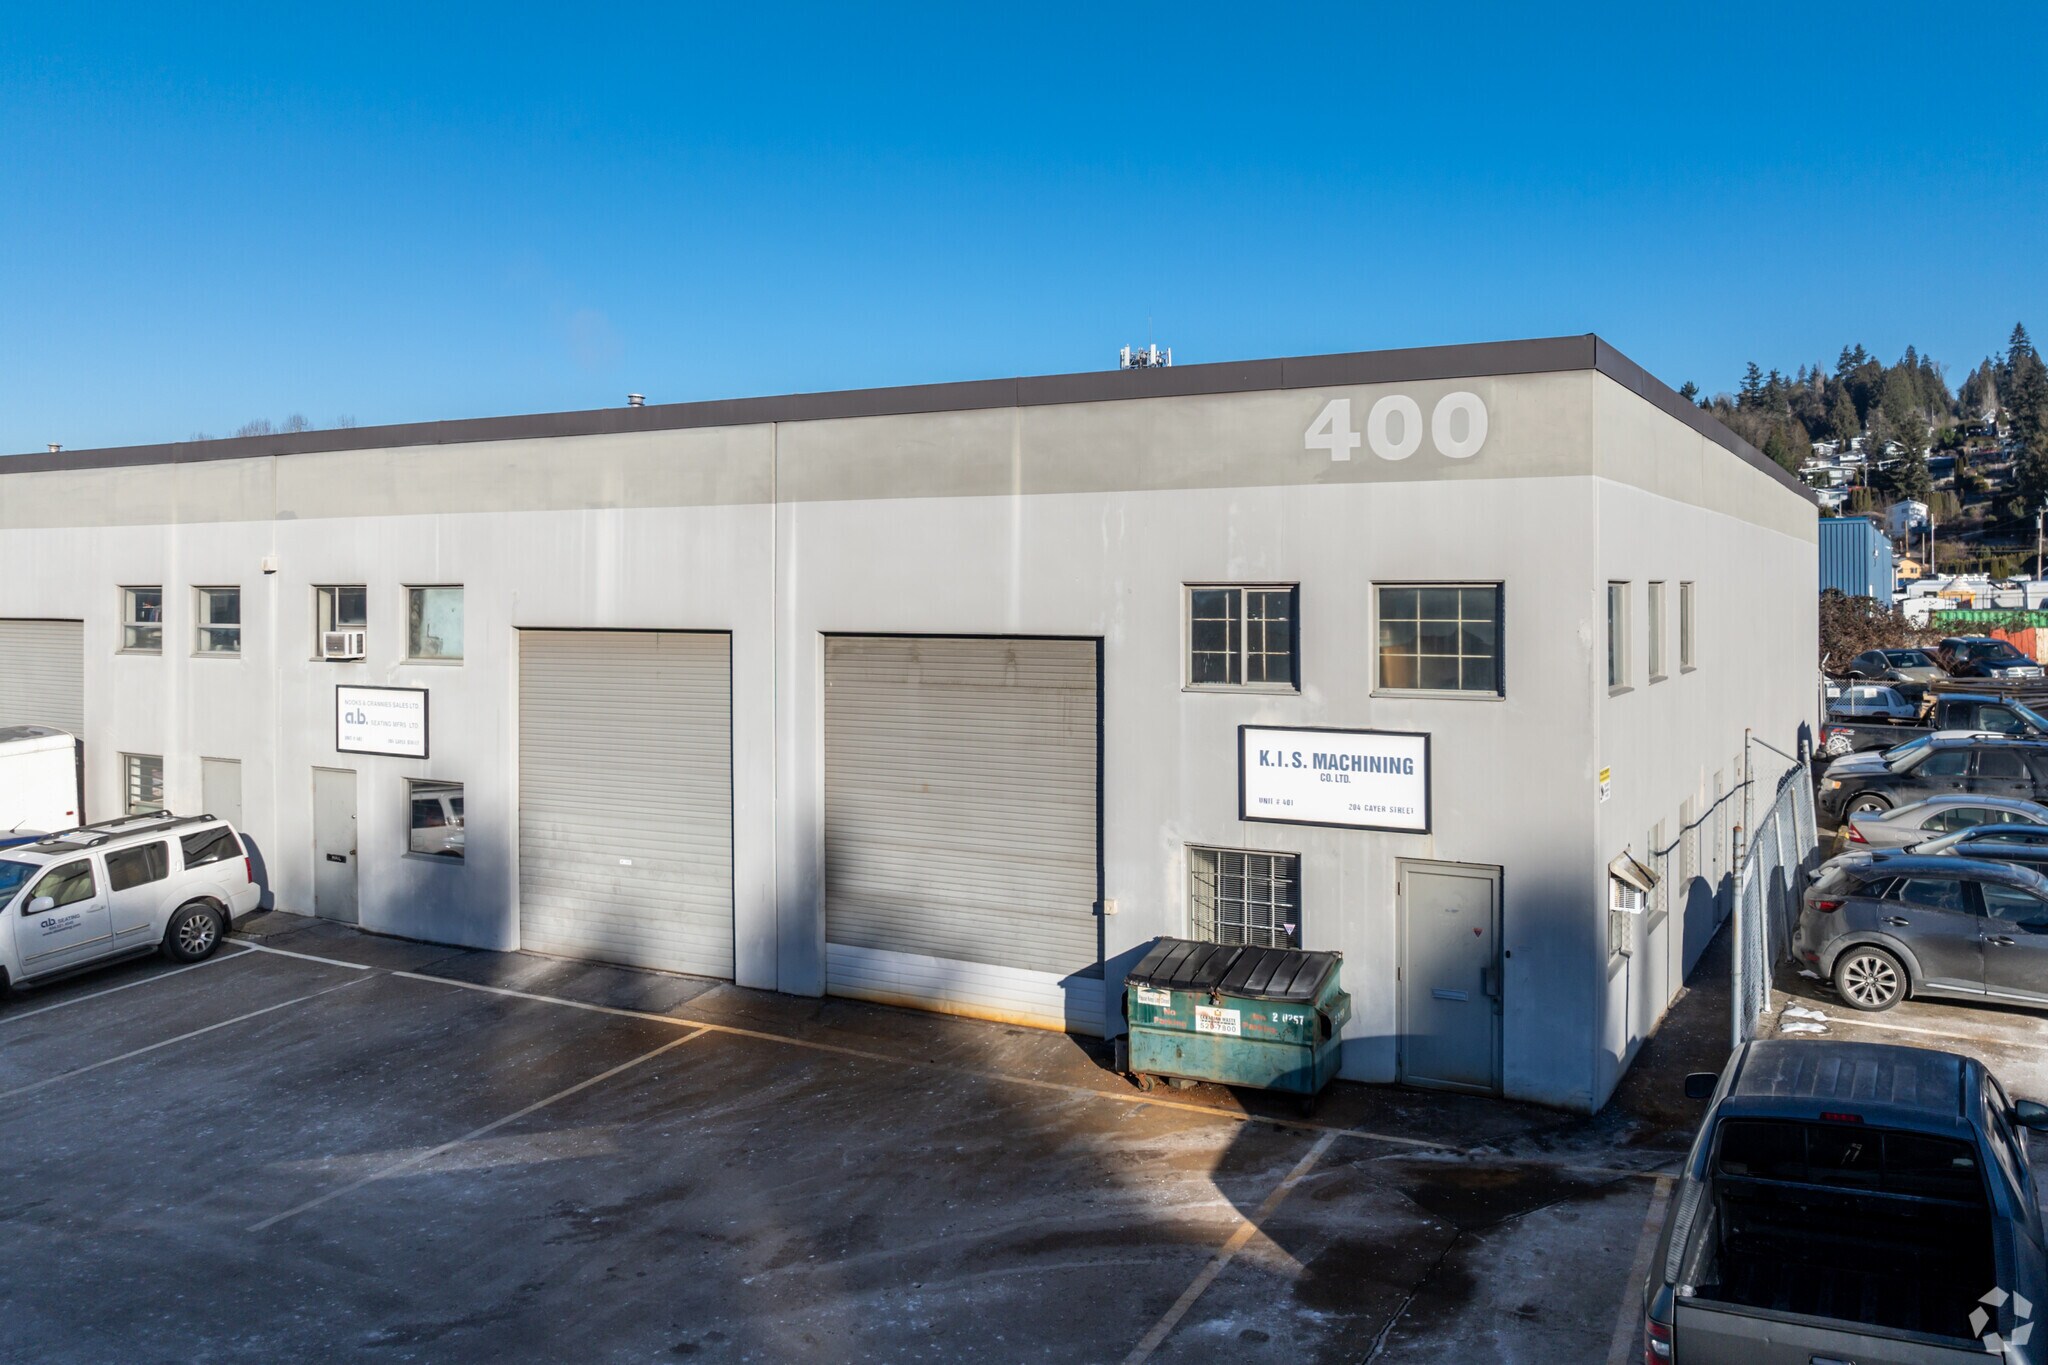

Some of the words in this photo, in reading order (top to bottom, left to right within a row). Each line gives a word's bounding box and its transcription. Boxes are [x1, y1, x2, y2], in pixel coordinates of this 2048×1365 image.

[1304, 391, 1489, 462] 400
[345, 708, 369, 725] a.b.
[1259, 750, 1308, 769] K.I.S.
[1312, 752, 1414, 775] MACHINING
[1320, 773, 1334, 783] CO.
[1335, 774, 1351, 784] LTD.
[1259, 797, 1273, 805] UNIT
[1349, 803, 1360, 811] 204
[1364, 804, 1386, 813] CAYER
[1389, 806, 1414, 815] STREET
[1272, 1012, 1279, 1023] 2
